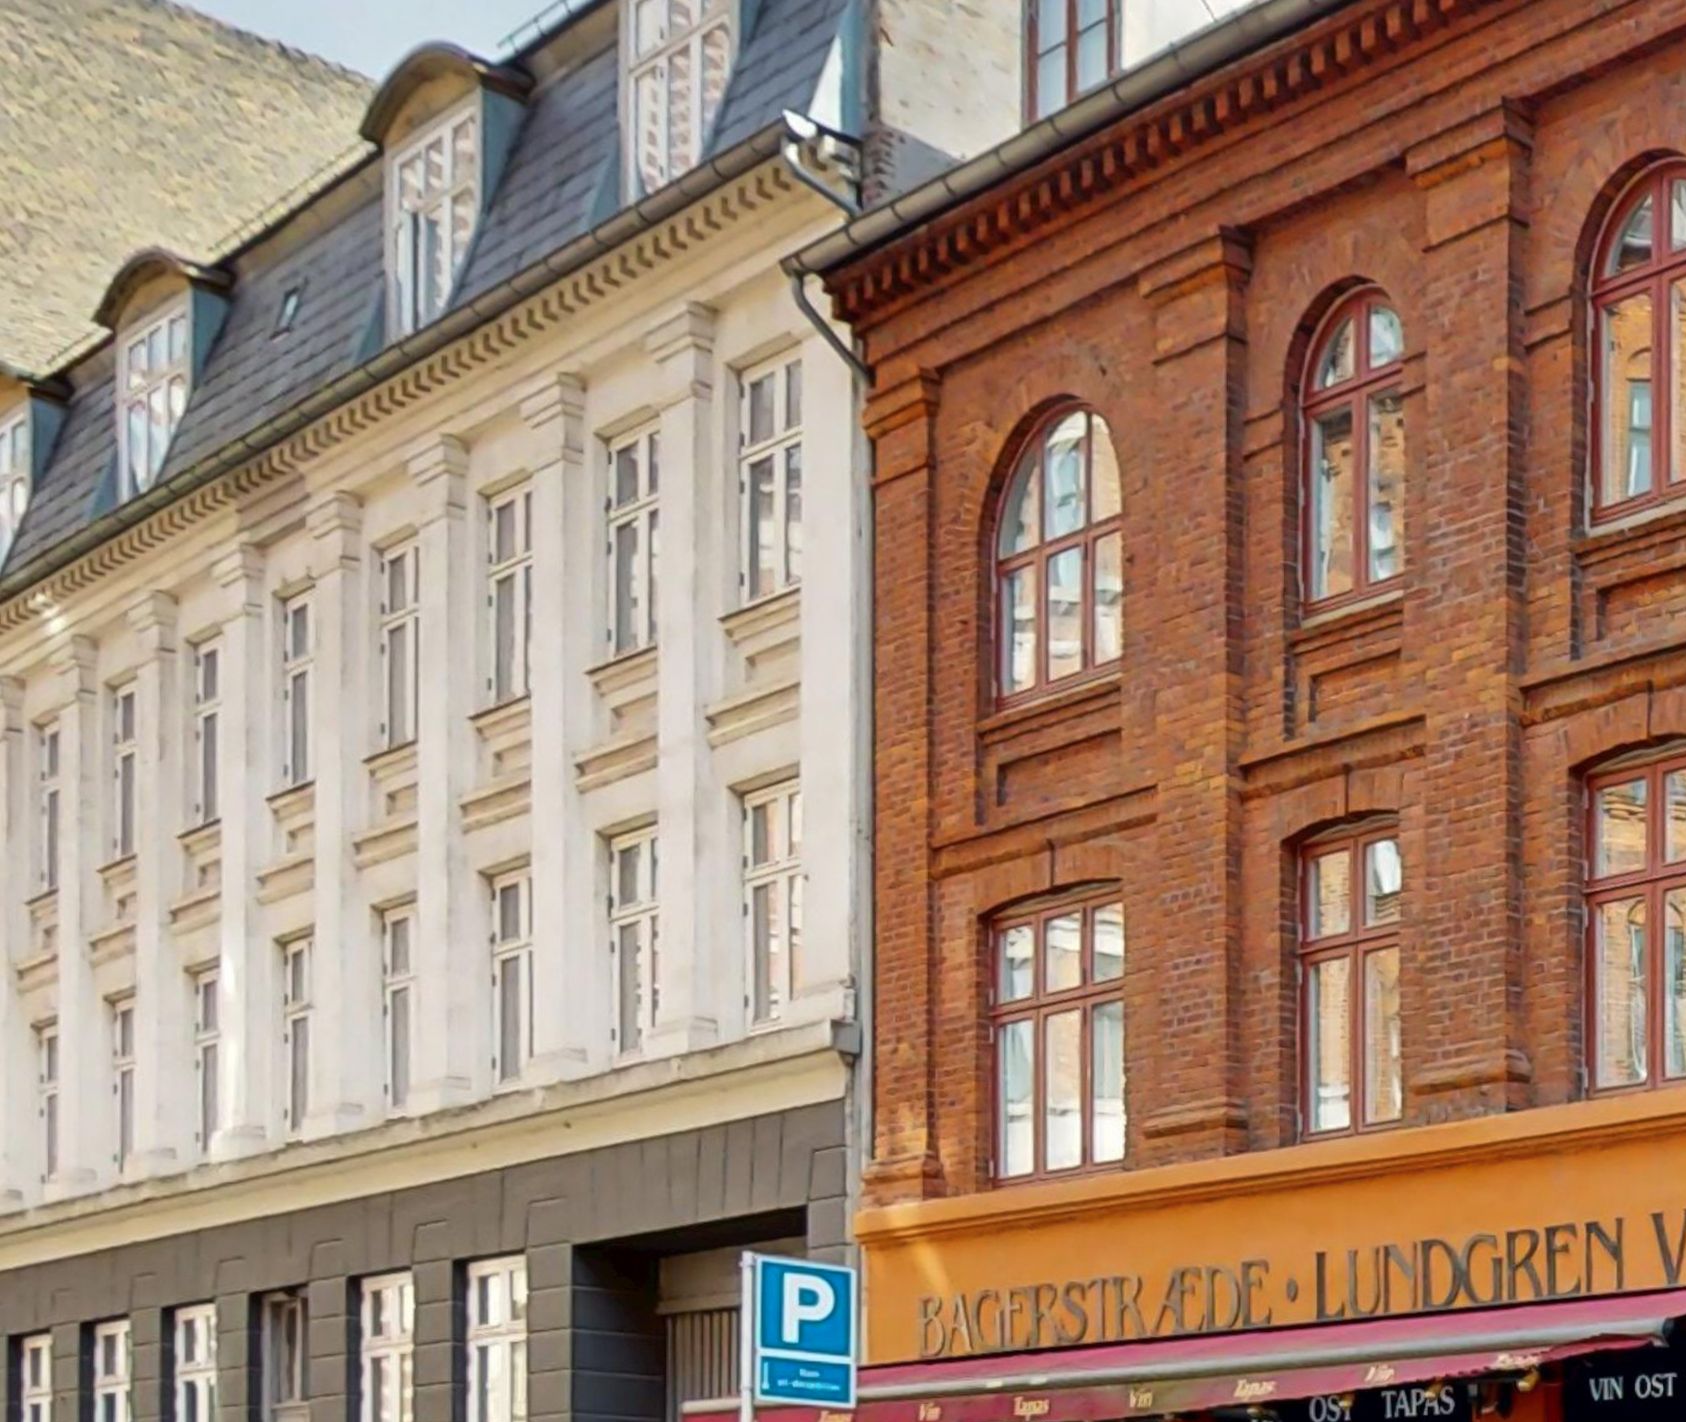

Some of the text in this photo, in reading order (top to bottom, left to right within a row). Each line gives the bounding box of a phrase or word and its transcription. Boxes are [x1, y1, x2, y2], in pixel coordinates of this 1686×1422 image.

[782, 1256, 836, 1344] P
[917, 1260, 1273, 1359] BAGERSTRÆDE
[1315, 1216, 1625, 1321] LUNDGREN
[1381, 1386, 1456, 1420] TAPAS
[1589, 1377, 1624, 1402] VIN
[1634, 1372, 1678, 1399] OST
